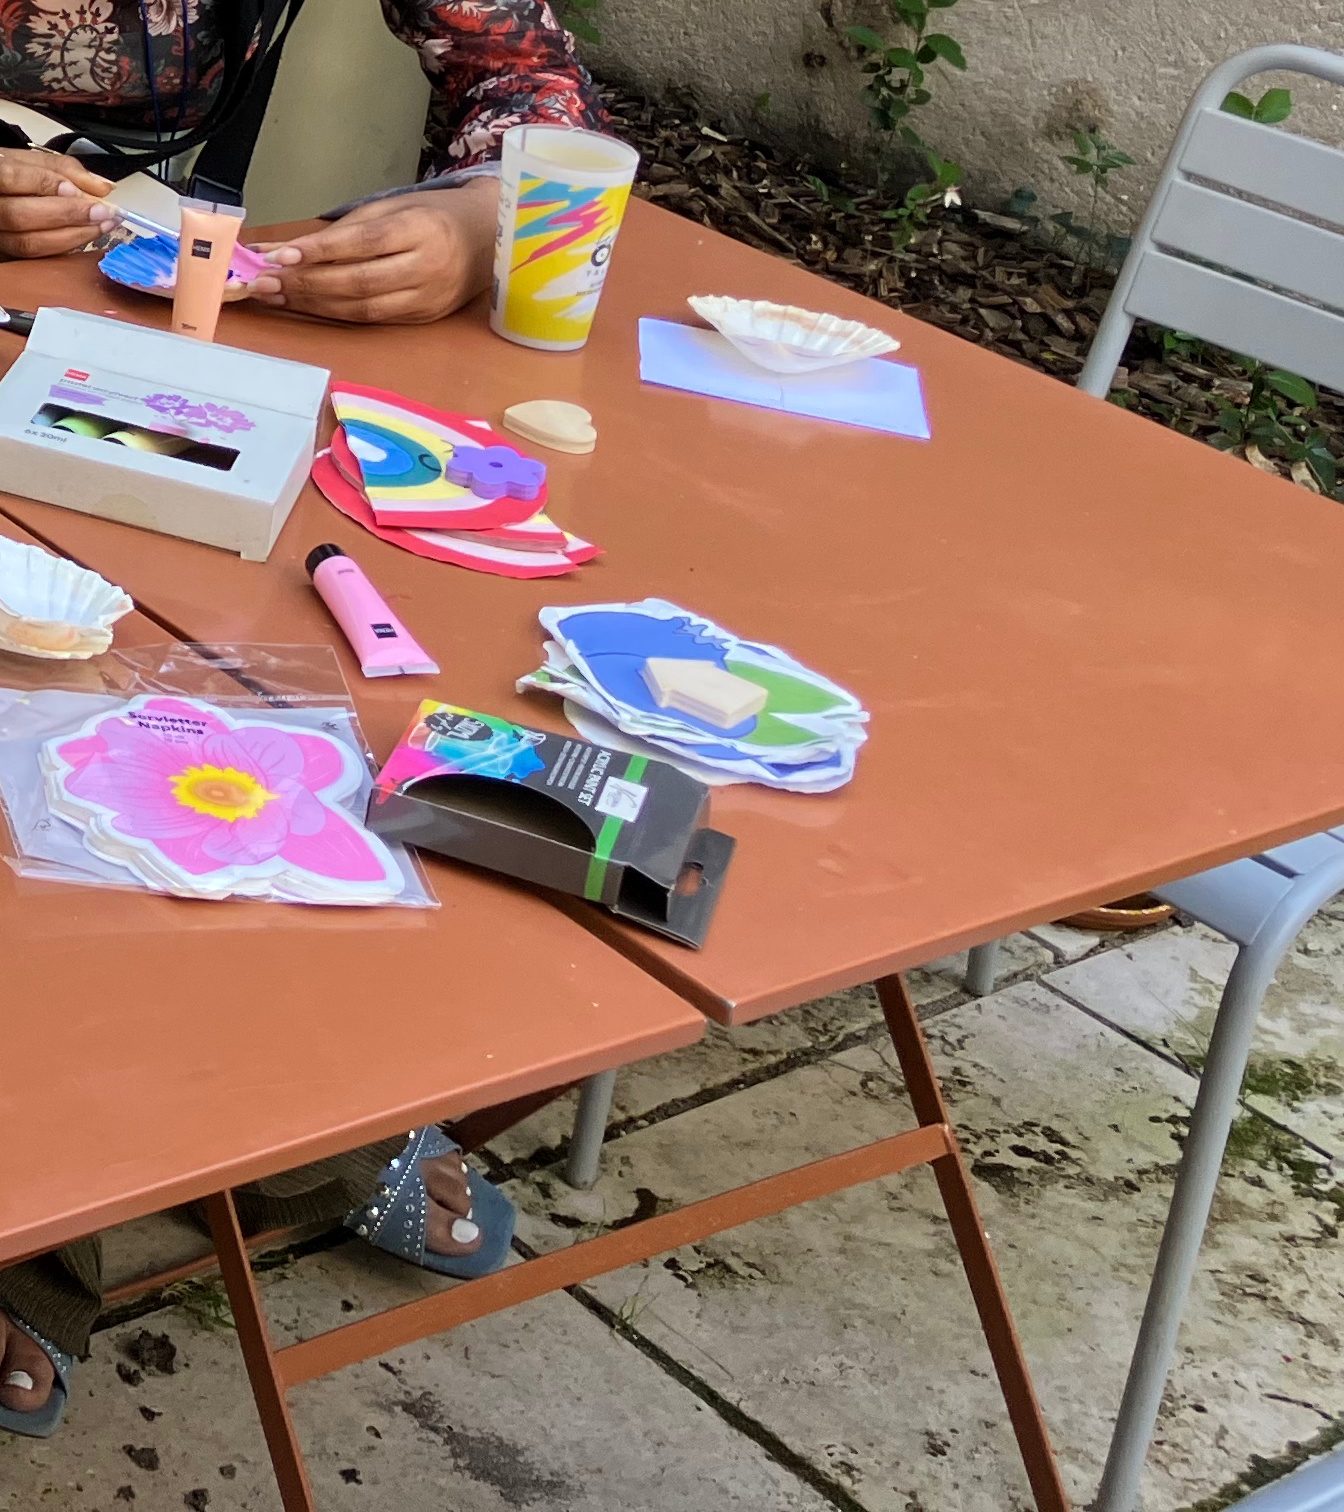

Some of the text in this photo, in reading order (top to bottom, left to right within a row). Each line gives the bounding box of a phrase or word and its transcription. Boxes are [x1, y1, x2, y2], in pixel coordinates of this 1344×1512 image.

[138, 720, 204, 736] Napkins
[581, 772, 602, 794] PAINT
[575, 790, 594, 806] SET
